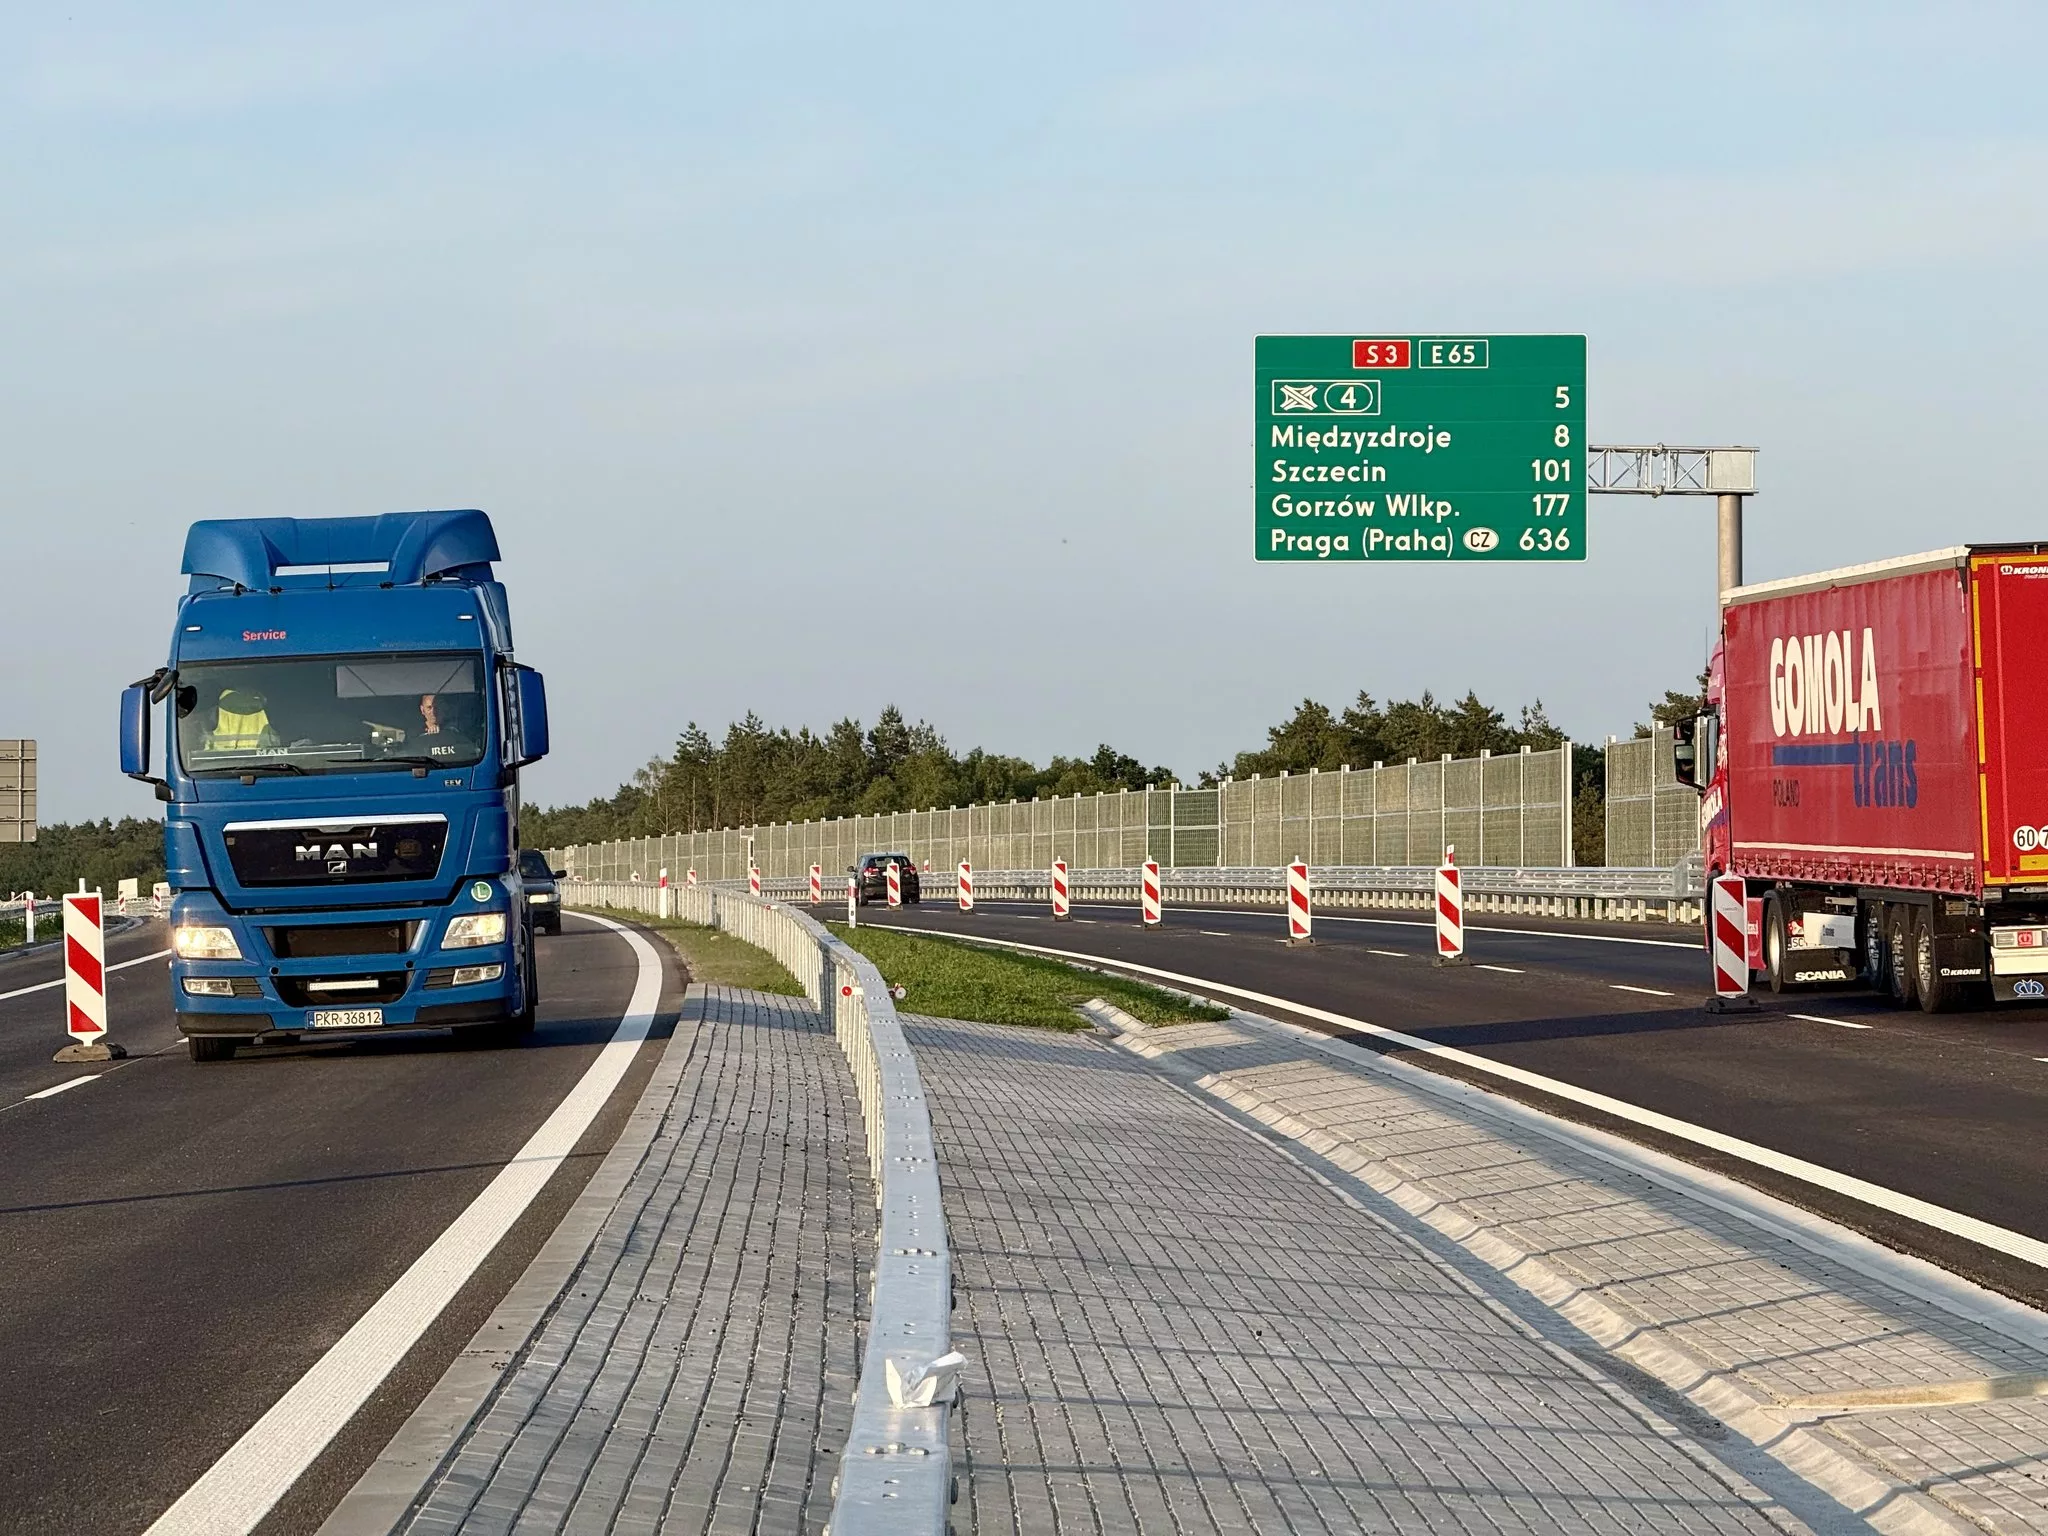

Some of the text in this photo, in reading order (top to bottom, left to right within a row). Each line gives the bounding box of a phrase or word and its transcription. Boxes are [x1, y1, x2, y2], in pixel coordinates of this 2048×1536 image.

[1448, 345, 1476, 364] 65
[1340, 386, 1570, 409] 4 5
[1271, 424, 1570, 455] Międzyzdroje 8
[1271, 459, 1570, 483] Szczecin 101
[1271, 493, 1570, 524] Gorzów Wlkp. 177
[1271, 527, 1570, 558] Praga (Praha) CZ 636
[2013, 566, 2048, 575] KRON
[242, 629, 287, 641] Service
[1769, 627, 1882, 738] GOMOLA
[431, 745, 456, 756] IREK
[1853, 728, 1918, 809] trans
[2016, 829, 2035, 847] 60
[295, 842, 378, 861] MAN
[1794, 969, 1847, 981] SCANIA
[1950, 968, 1982, 976] KRONE
